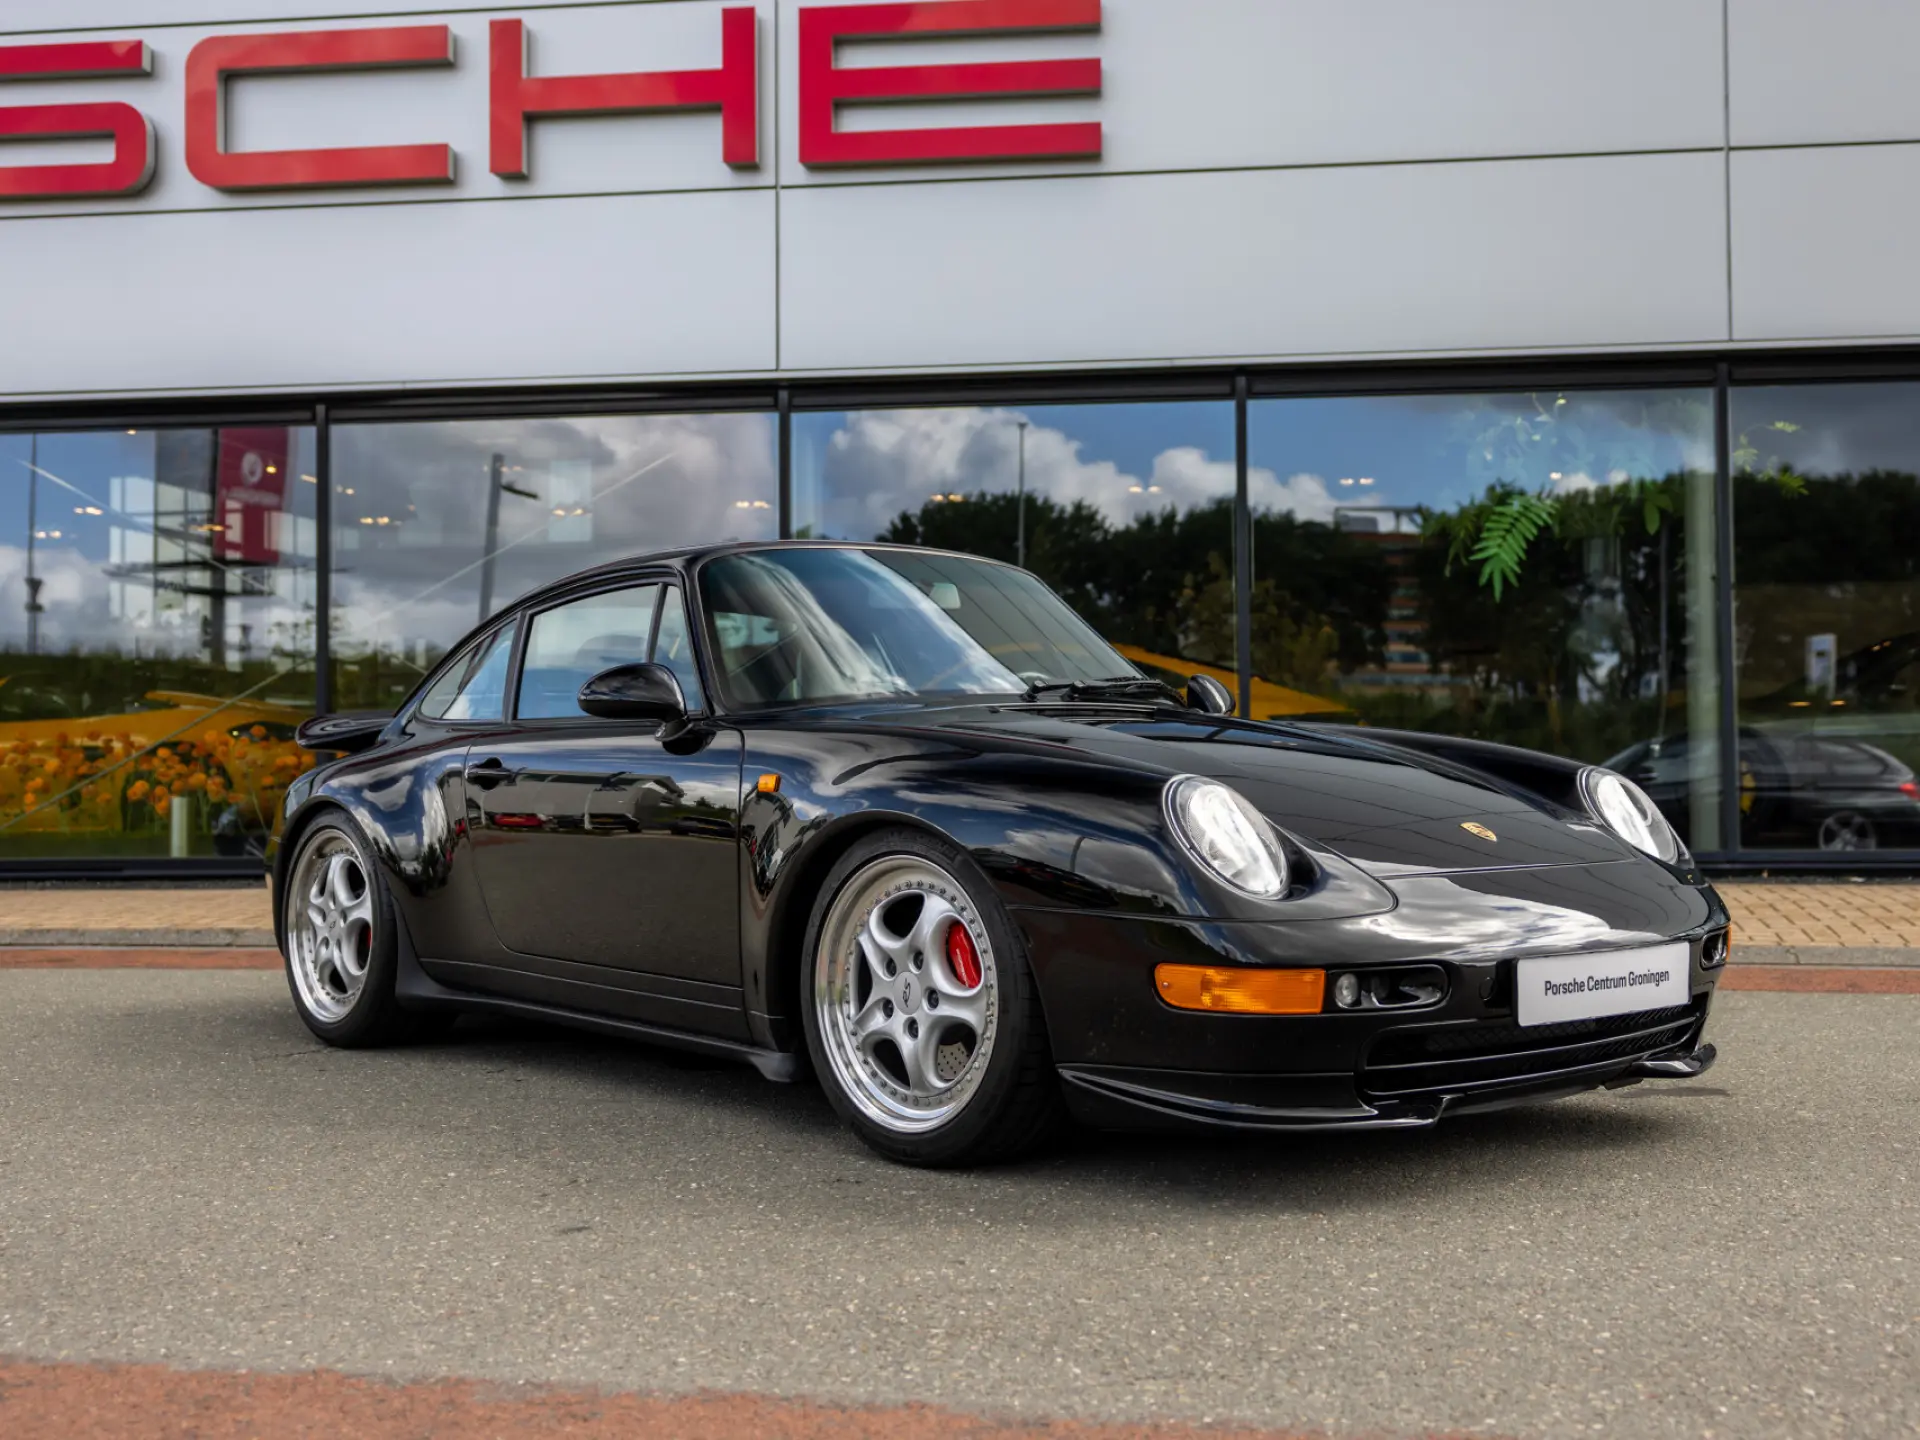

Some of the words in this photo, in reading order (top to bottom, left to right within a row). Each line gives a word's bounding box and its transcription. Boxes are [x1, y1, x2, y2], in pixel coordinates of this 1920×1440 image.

[1544, 978, 1585, 996] Porsche
[1587, 976, 1627, 991] Centrum
[1628, 969, 1670, 987] Groningen
